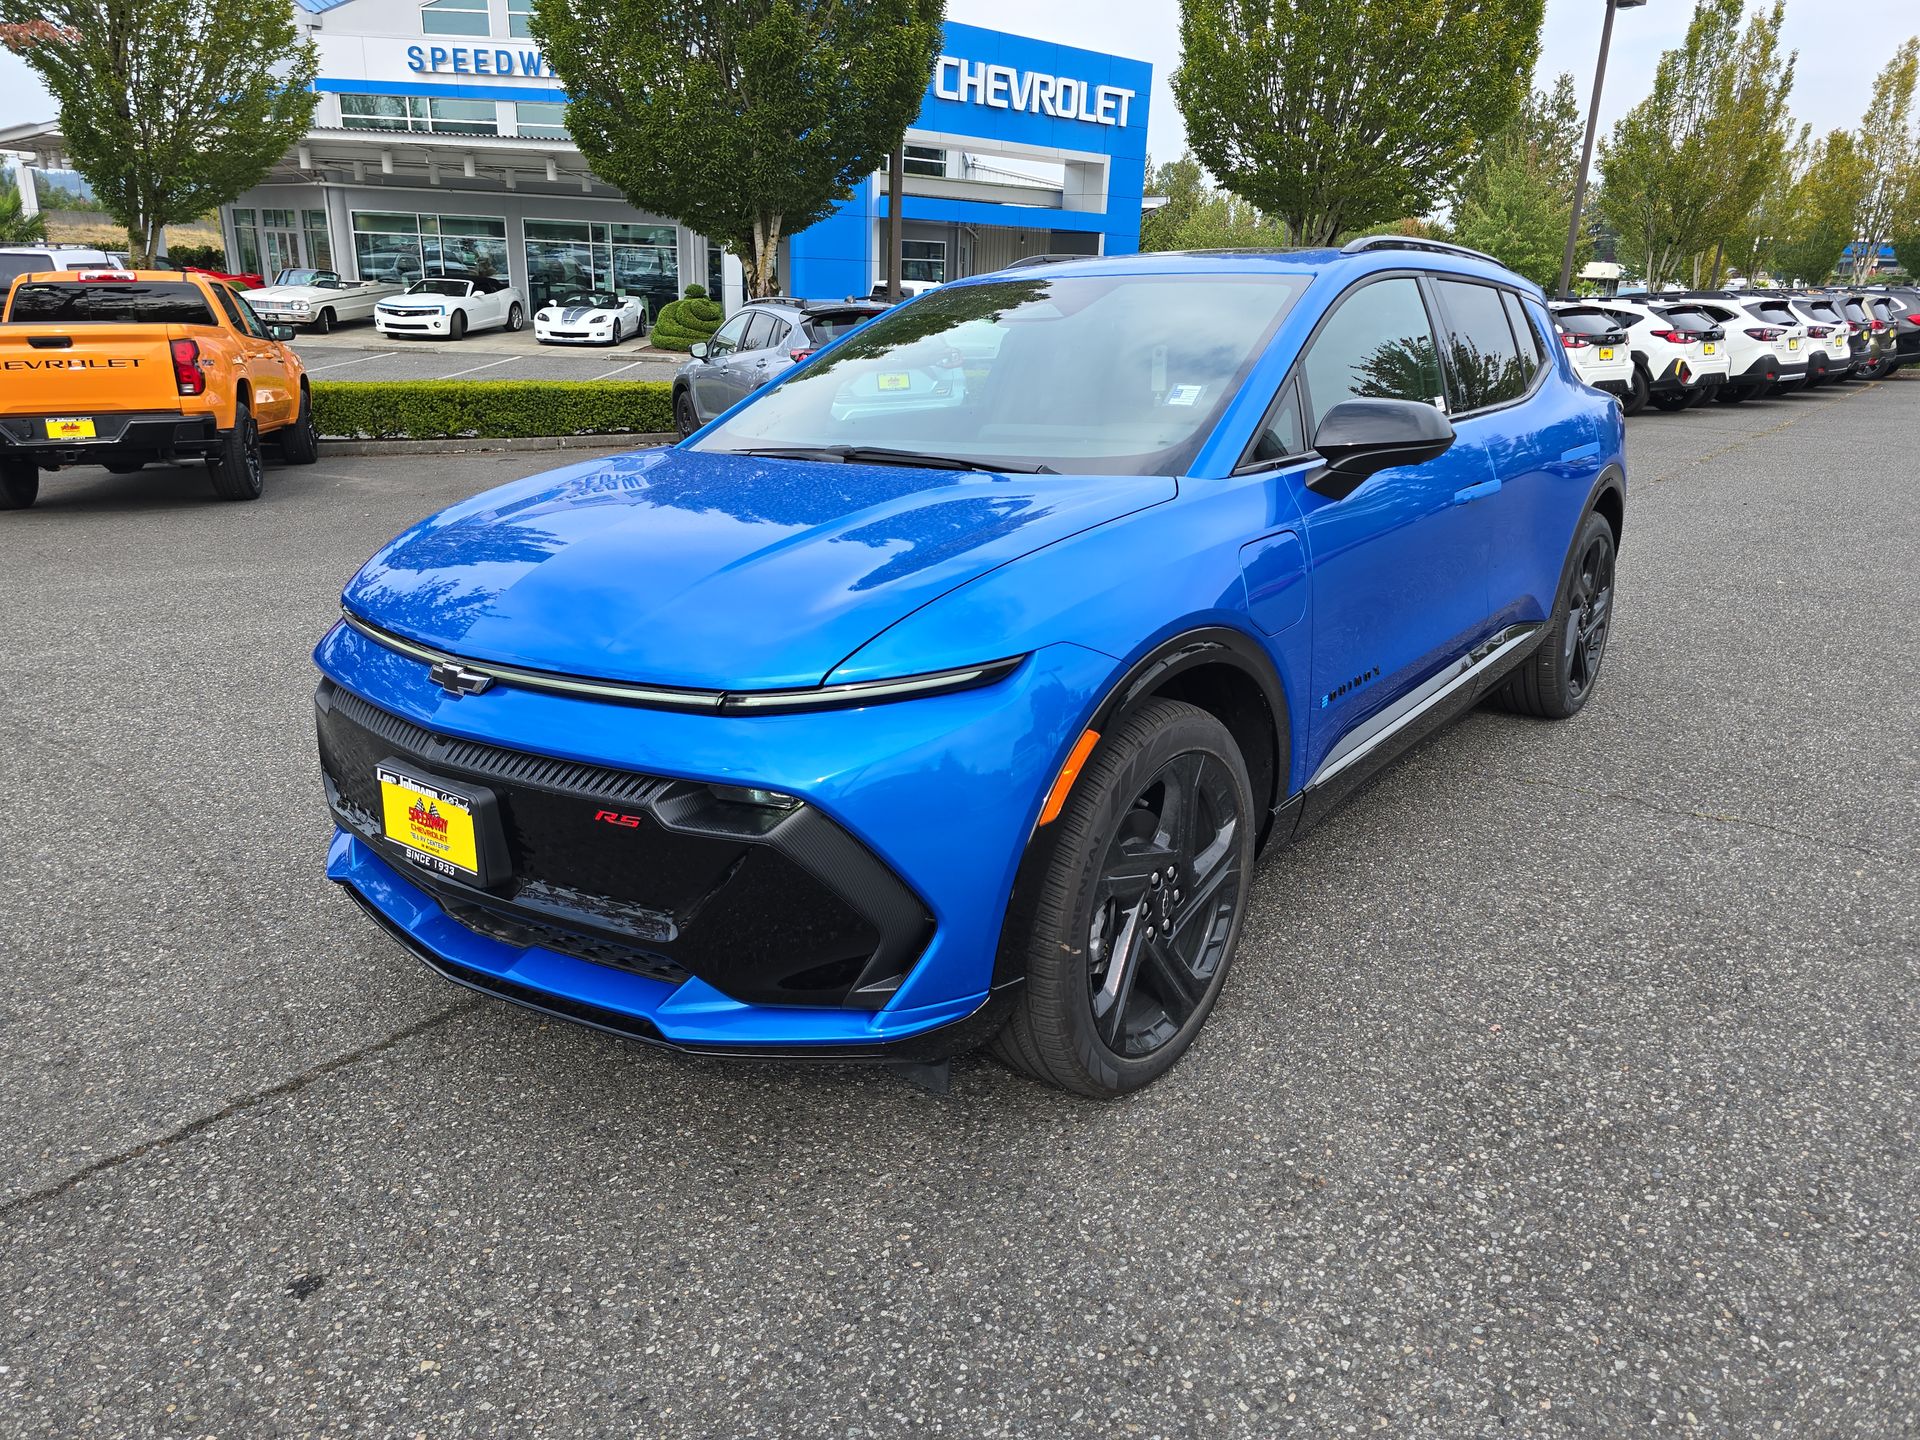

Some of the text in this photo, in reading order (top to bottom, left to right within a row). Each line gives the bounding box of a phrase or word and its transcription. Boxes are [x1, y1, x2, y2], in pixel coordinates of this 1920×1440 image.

[934, 55, 1136, 128] CHEVROLET
[0, 358, 145, 371] EVROLET
[399, 775, 439, 801] Johnson
[408, 806, 449, 834] SPEEDWAY
[594, 809, 642, 828] RS
[411, 824, 448, 843] CHEVROLET
[406, 848, 430, 866] SINCE
[434, 859, 455, 876] 1933
